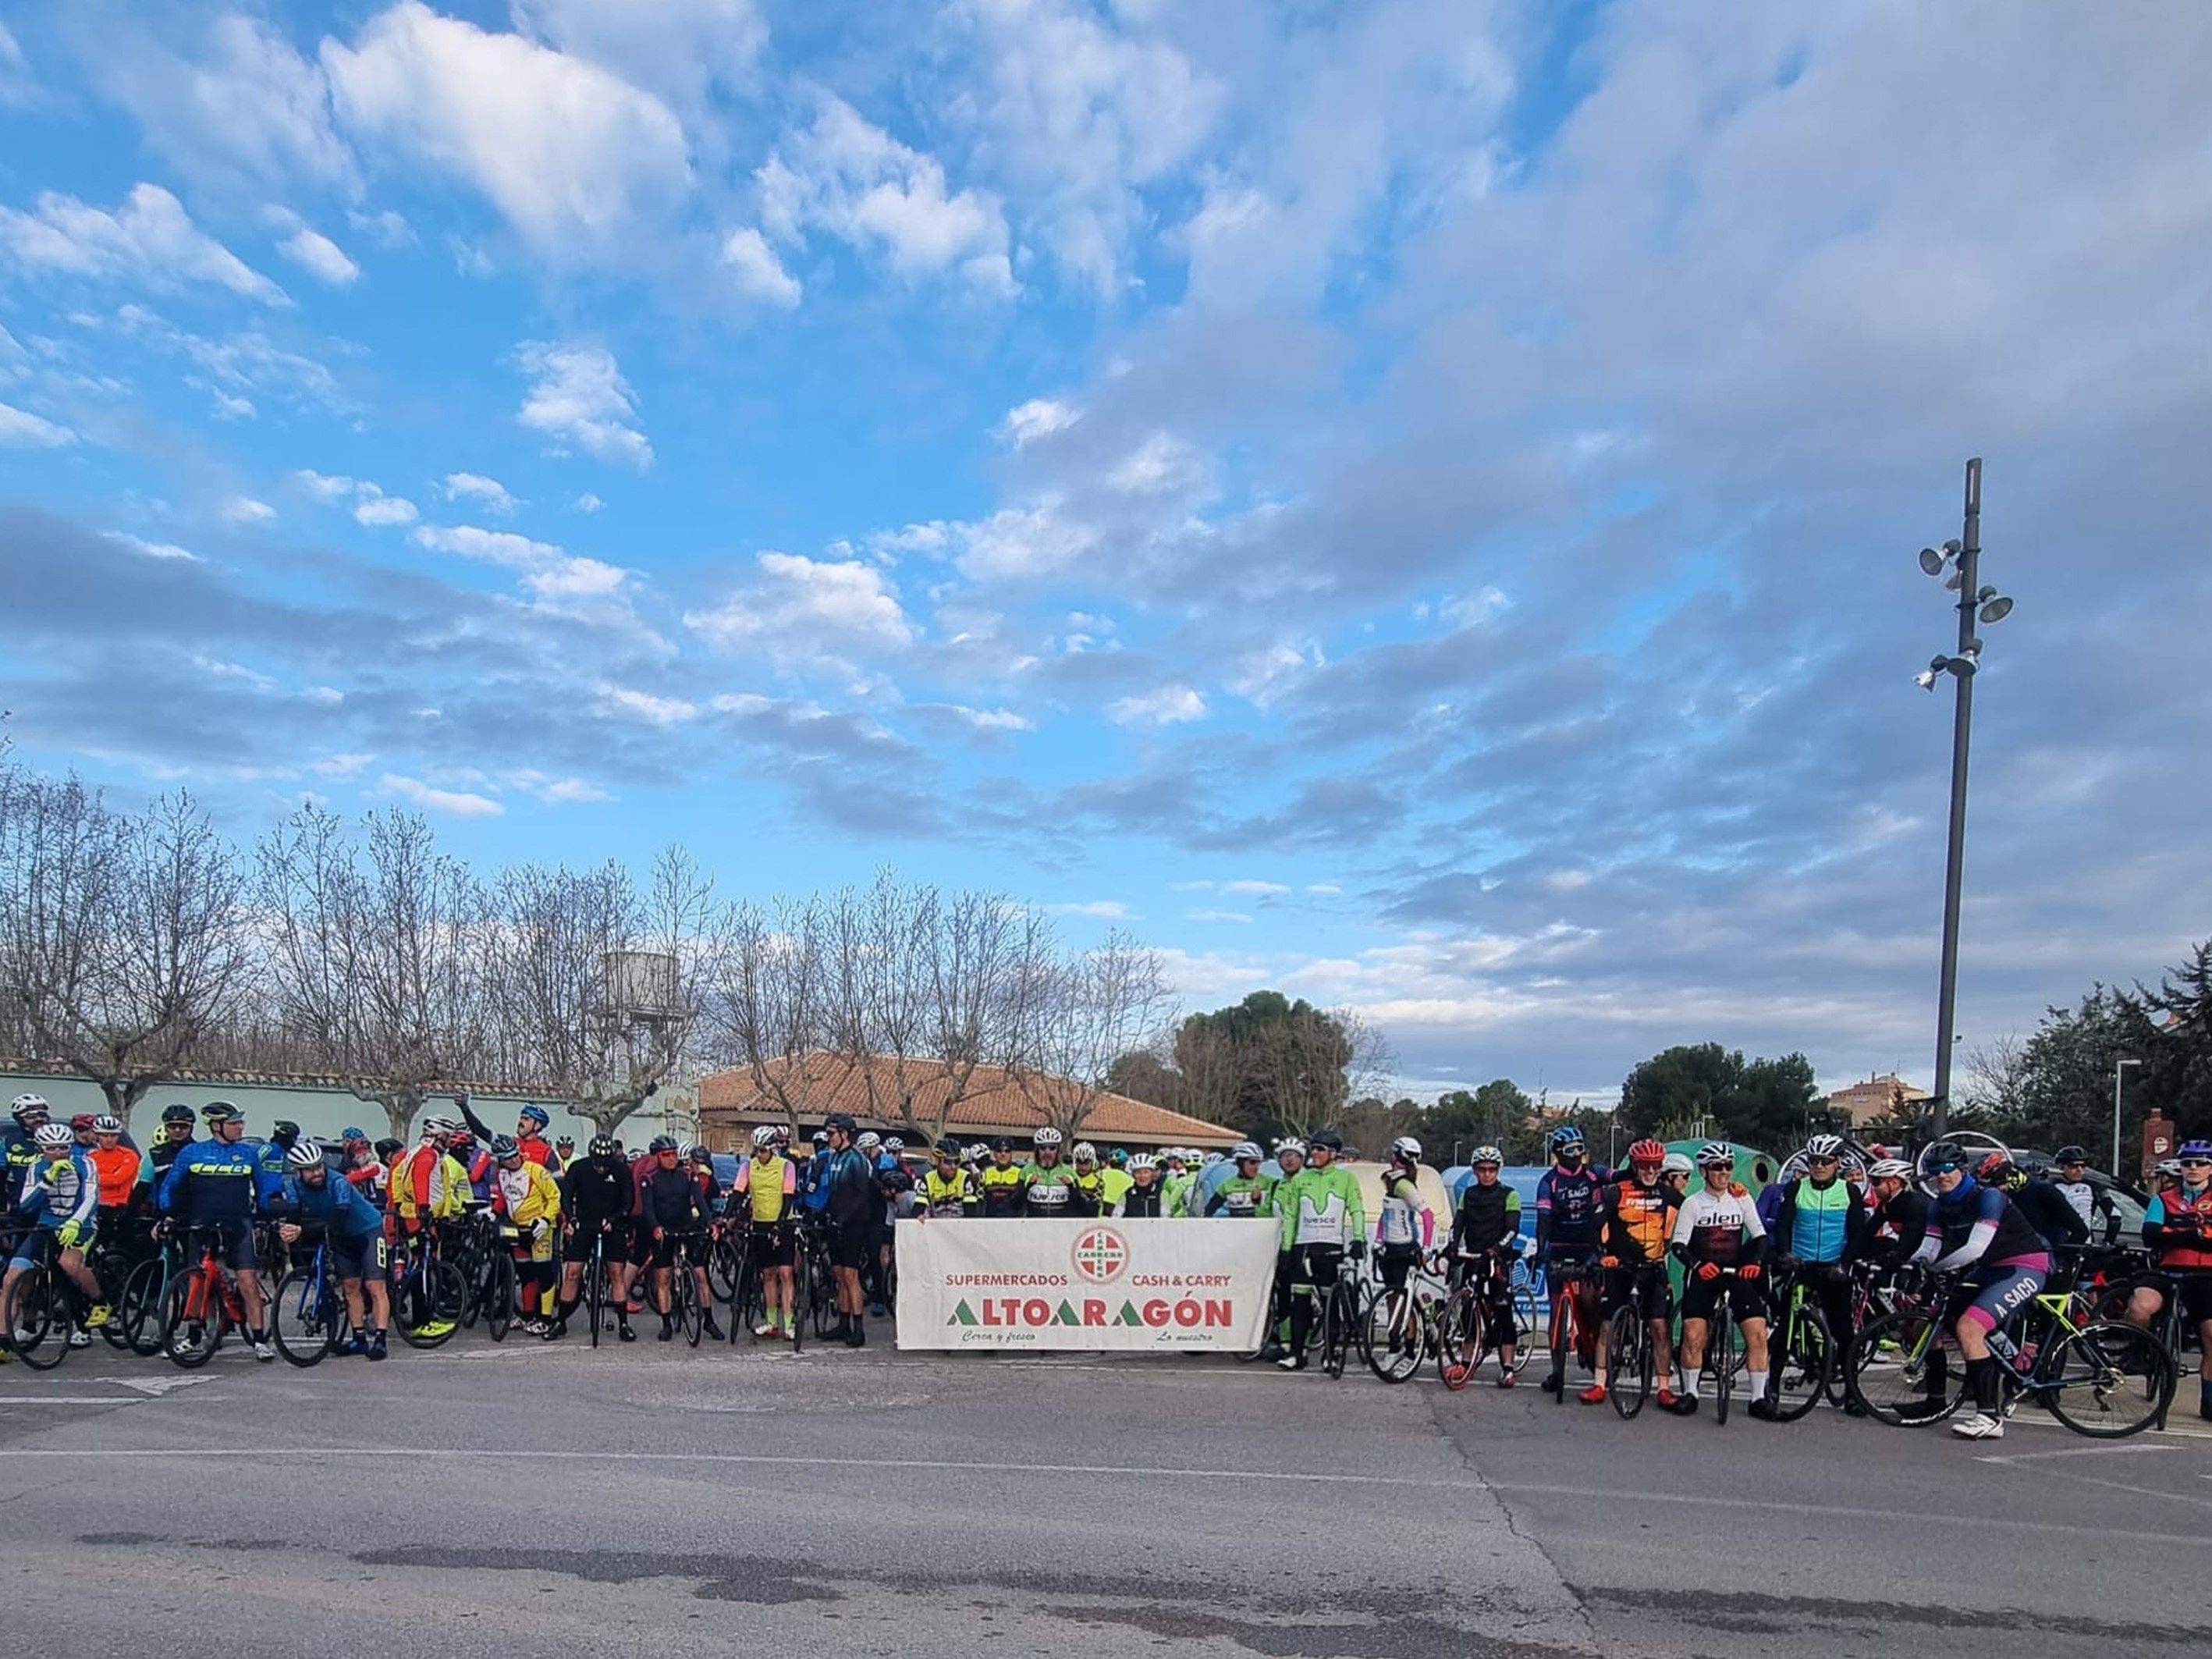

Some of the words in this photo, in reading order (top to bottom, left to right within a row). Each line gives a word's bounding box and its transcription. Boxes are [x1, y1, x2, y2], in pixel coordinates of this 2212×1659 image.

[946, 1274, 1069, 1286] SUPERMERCADOS
[1132, 1274, 1169, 1286] CASH
[1185, 1274, 1232, 1287] CARRY
[2004, 1277, 2038, 1309] SACO
[946, 1290, 1233, 1327] ALTOARAGÓN
